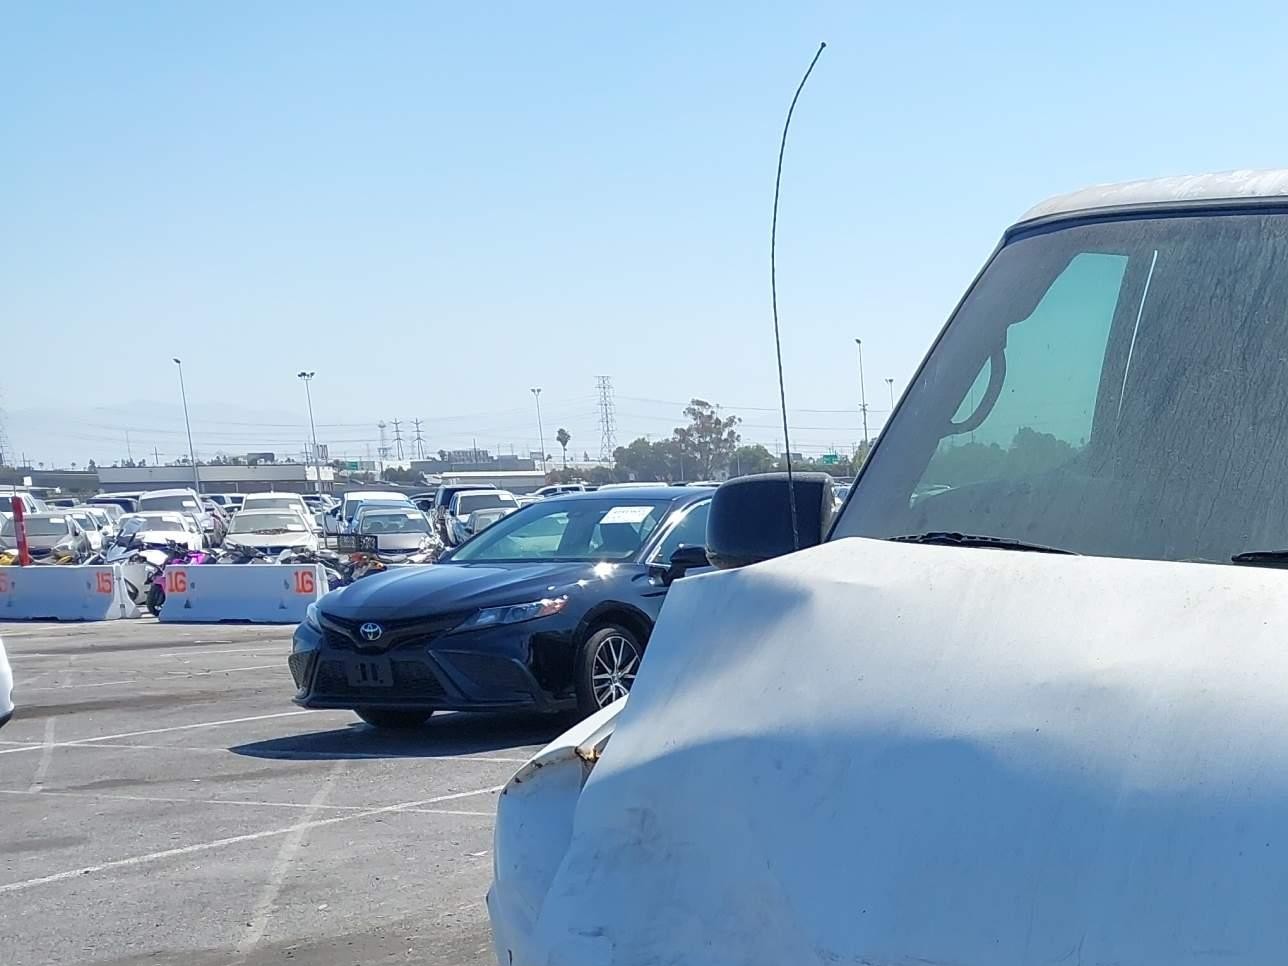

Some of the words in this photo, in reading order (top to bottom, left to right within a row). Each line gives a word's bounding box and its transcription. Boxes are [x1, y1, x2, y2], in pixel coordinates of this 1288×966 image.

[95, 571, 112, 593] 15
[168, 571, 187, 593] 16
[294, 571, 314, 593] 16
